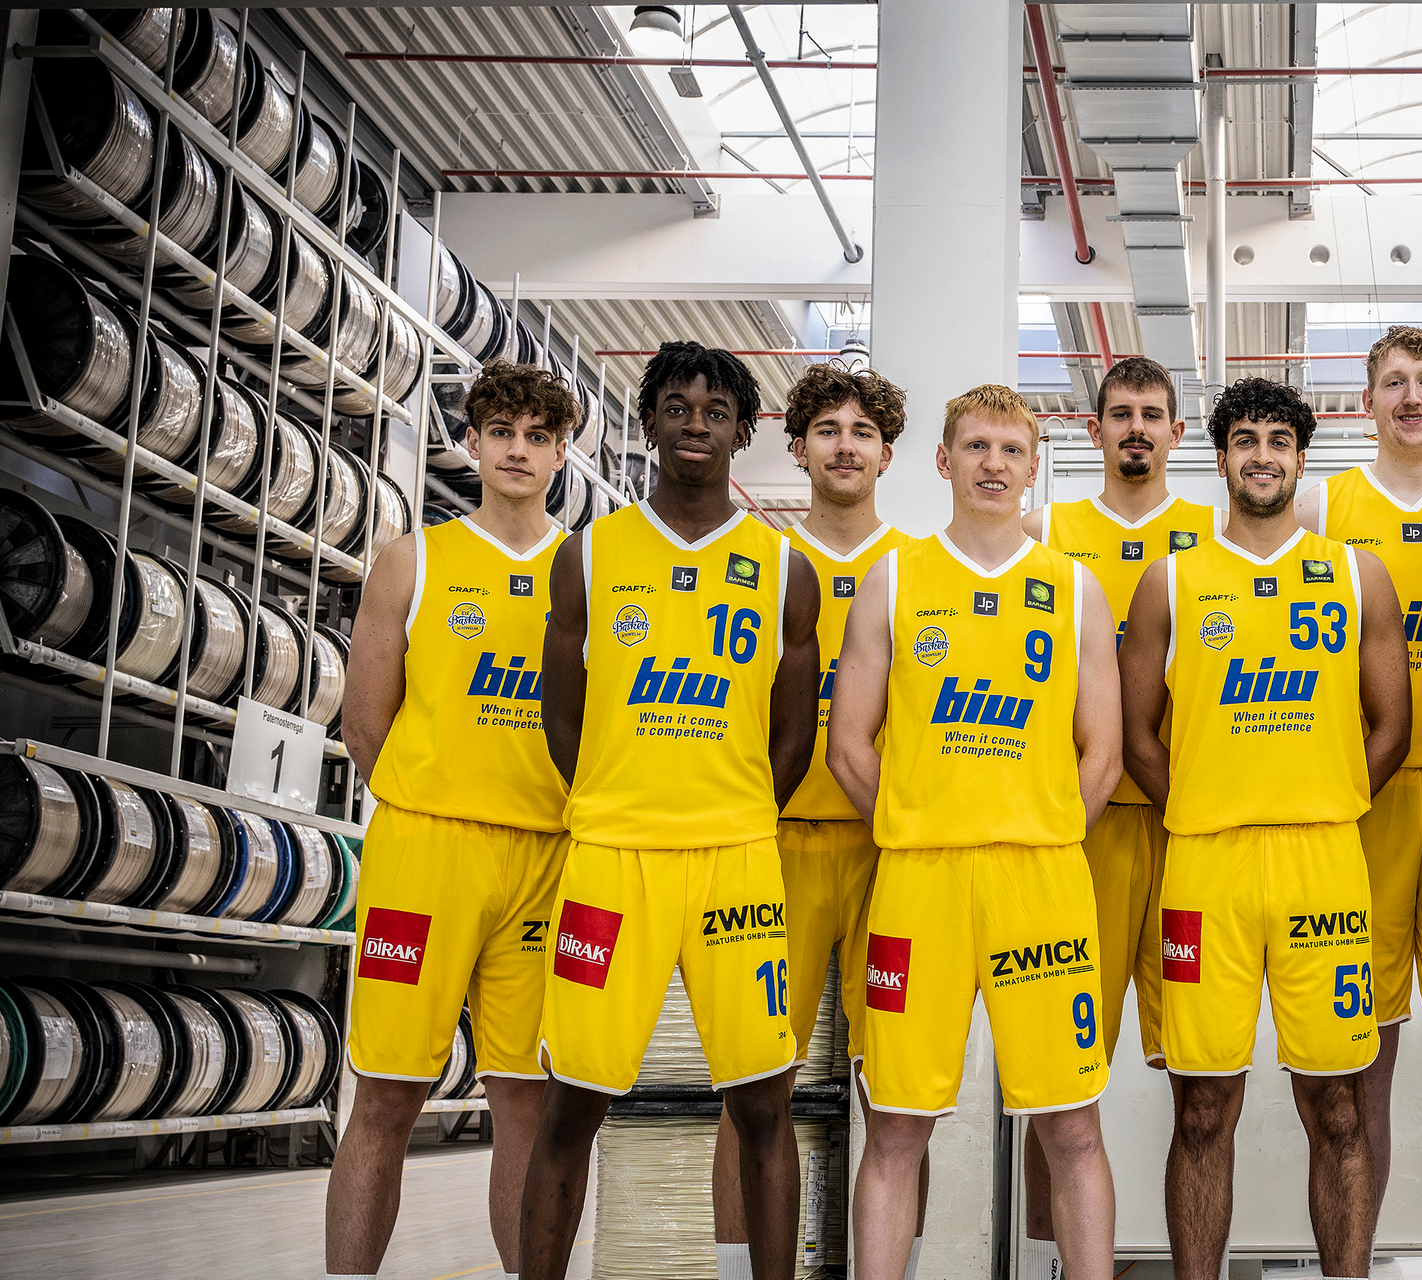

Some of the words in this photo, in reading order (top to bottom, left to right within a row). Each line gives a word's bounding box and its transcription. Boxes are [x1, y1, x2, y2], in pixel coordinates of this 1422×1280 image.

[1345, 538, 1375, 546] CRAFT
[728, 576, 755, 586] BARMER
[448, 586, 481, 594] CRAFT
[1198, 594, 1229, 602] CRAFT
[1028, 600, 1052, 611] BARMER
[448, 613, 486, 626] Baskets
[612, 616, 650, 634] Baskets
[706, 604, 761, 664] 16
[1200, 622, 1234, 638] Baskets
[1290, 602, 1347, 654] 53
[914, 637, 950, 655] Baskets
[1024, 630, 1053, 682] 9
[627, 656, 730, 709] biw
[1220, 656, 1319, 704] biw
[481, 704, 512, 715] When
[516, 708, 522, 717] it
[930, 676, 1034, 730] biw
[477, 717, 488, 725] to
[492, 718, 544, 730] competen
[639, 712, 672, 724] When
[677, 714, 686, 724] it
[690, 716, 728, 728] comes
[1234, 711, 1266, 722] When
[1269, 710, 1276, 720] it
[1280, 710, 1315, 720] comes
[636, 727, 644, 736] to
[649, 728, 724, 740] competence
[1230, 723, 1240, 734] to
[1243, 722, 1312, 734] competence
[944, 731, 976, 744] When
[979, 733, 988, 744] it
[992, 736, 1026, 750] comes
[941, 744, 952, 754] to
[954, 745, 1022, 760] competence
[271, 740, 285, 793] 1
[702, 902, 784, 936] ZWICK
[1289, 910, 1368, 938] ZWICK
[706, 935, 745, 948] ARMATUREN
[747, 932, 766, 941] GMBH
[1290, 940, 1333, 948] ARMATUREN
[1336, 938, 1354, 946] GMBH
[990, 938, 1090, 978] ZWICK
[994, 974, 1041, 988] ARMATUREN
[1044, 968, 1066, 978] GMBH
[1334, 962, 1372, 1019] 53
[1072, 992, 1096, 1050] 9
[1078, 1064, 1094, 1074] CRA
